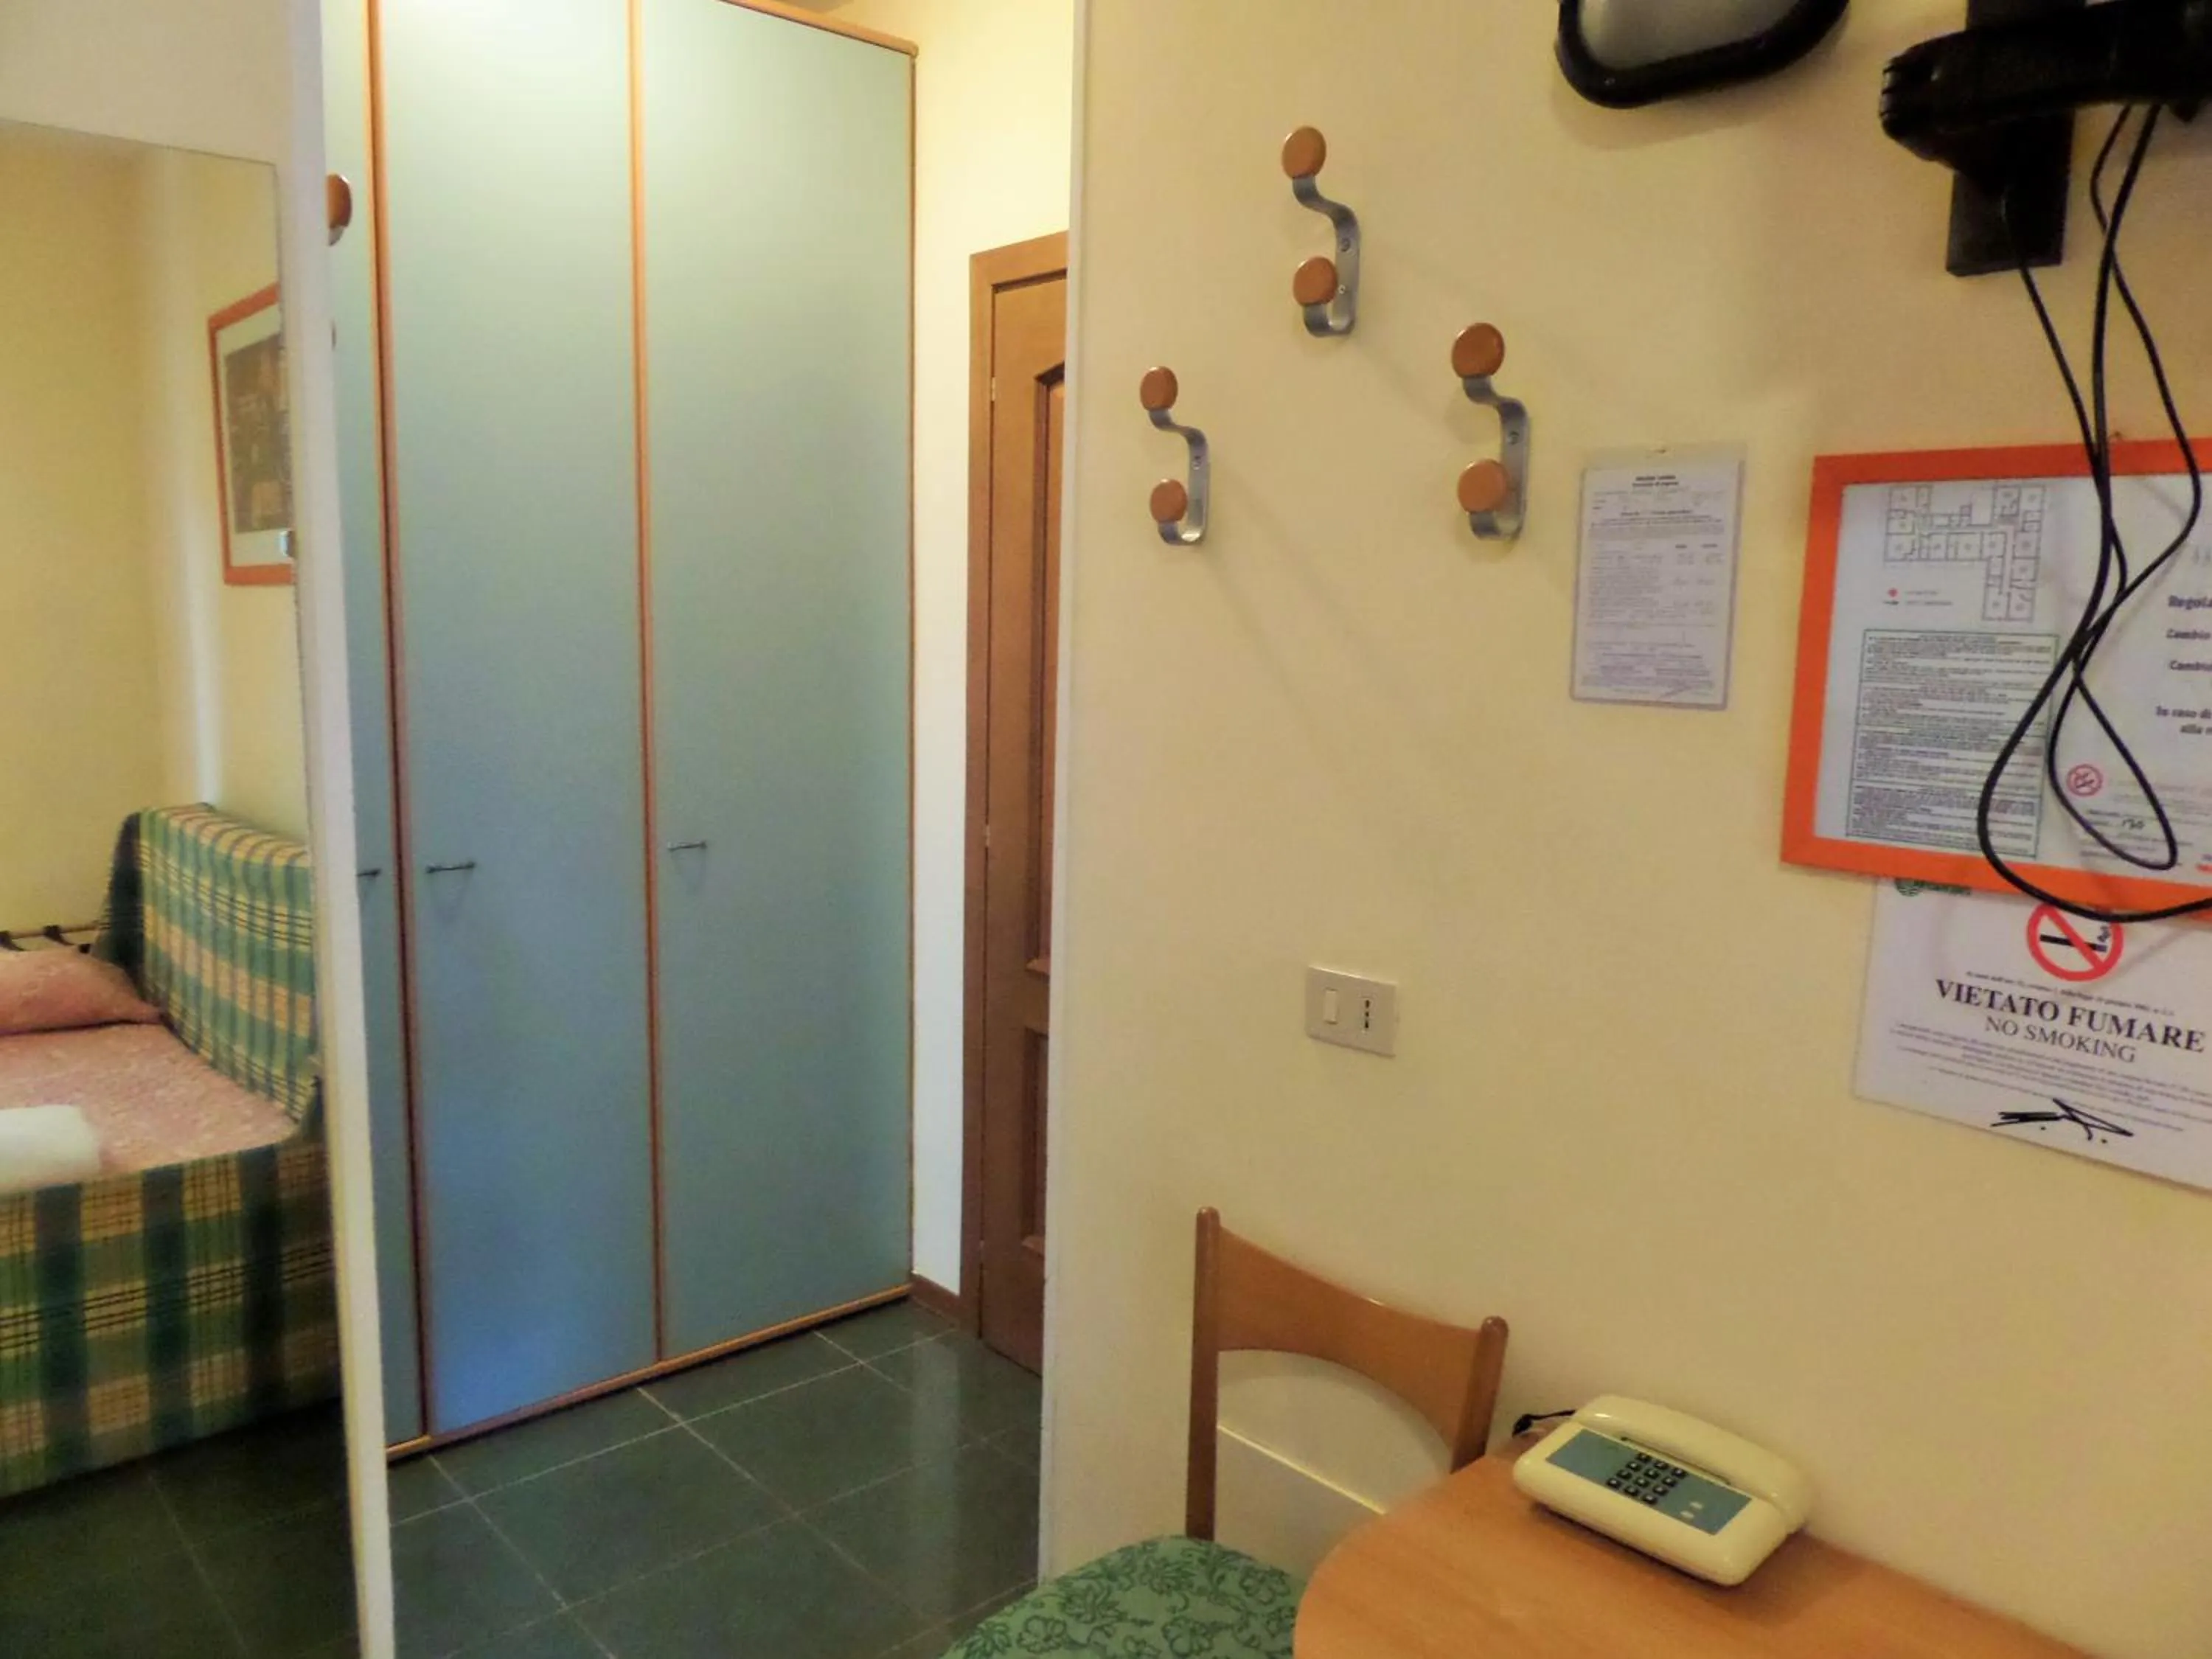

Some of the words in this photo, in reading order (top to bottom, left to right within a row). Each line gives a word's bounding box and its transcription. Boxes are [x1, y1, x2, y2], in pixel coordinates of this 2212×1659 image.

[2166, 629, 2211, 639] Cambio
[1935, 978, 2059, 1021] VIETATO
[2067, 1006, 2206, 1053] FUMARE
[1986, 1015, 2019, 1036] NO
[2024, 1024, 2136, 1062] SMOKING
